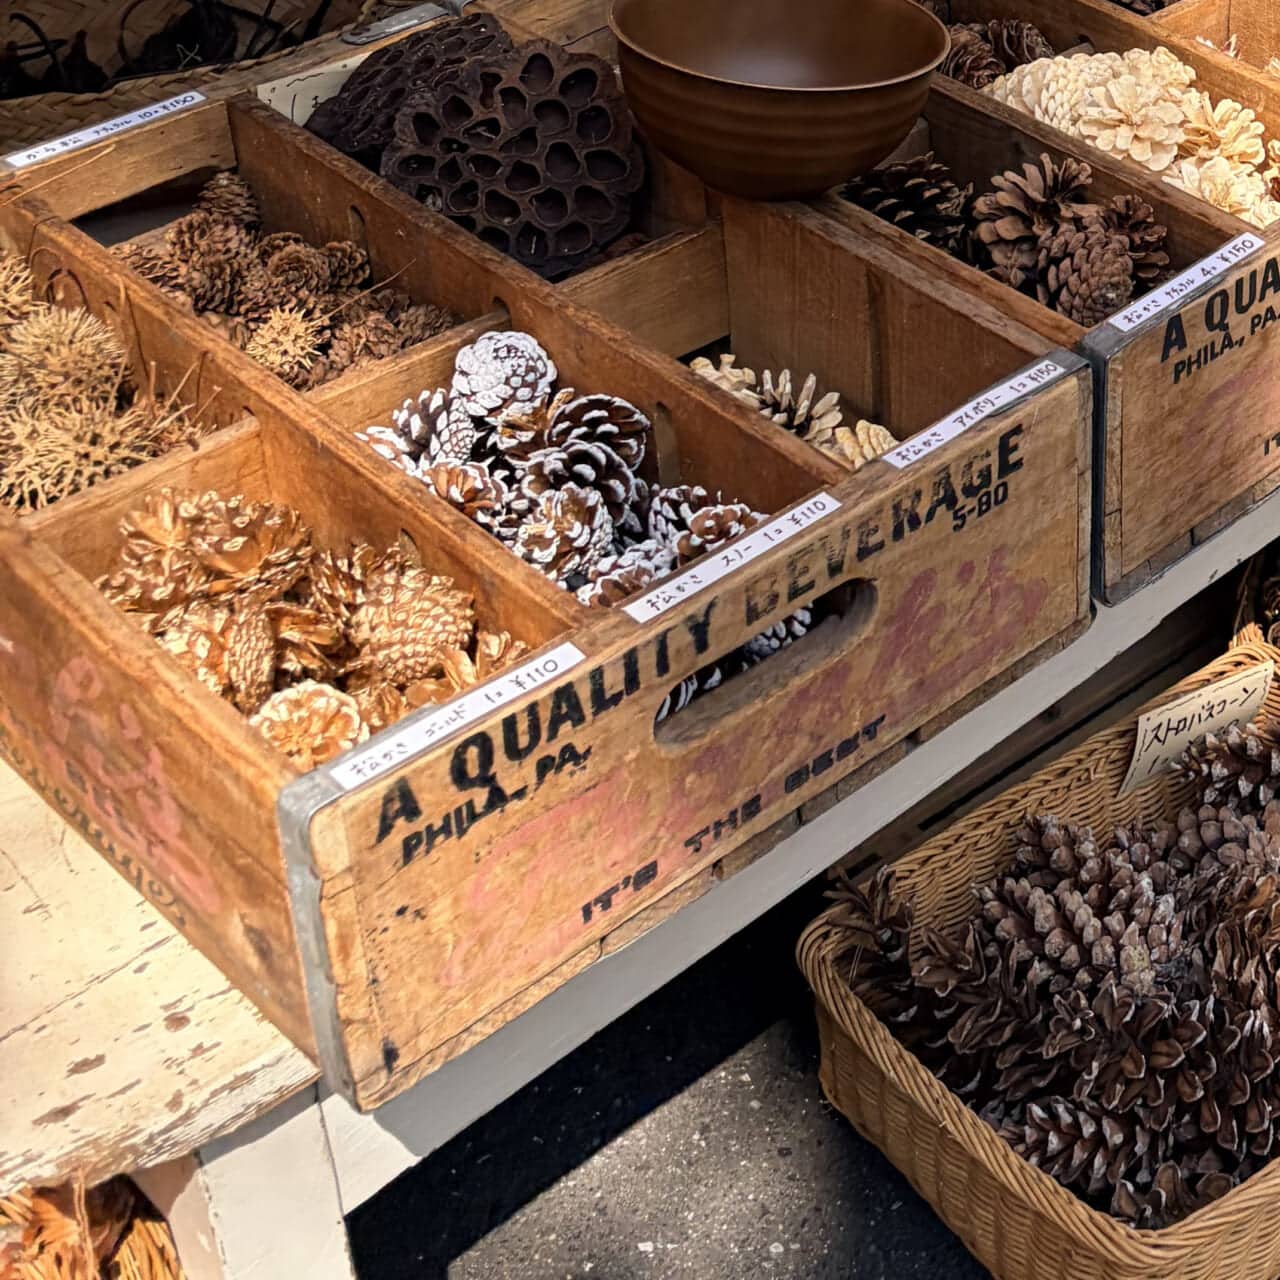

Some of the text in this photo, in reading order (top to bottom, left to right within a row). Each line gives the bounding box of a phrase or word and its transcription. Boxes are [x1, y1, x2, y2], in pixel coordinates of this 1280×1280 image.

[1122, 299, 1162, 325] 松かさ
[1216, 238, 1255, 264] ¥150
[1161, 312, 1187, 363] A
[895, 431, 945, 463] 松かさ
[952, 394, 1002, 428] アイボリー
[1025, 363, 1058, 385] ¥150
[646, 574, 704, 612] 松かさ
[720, 544, 753, 568] スノー
[787, 500, 827, 528] ¥110
[951, 480, 1010, 533] 5-80
[375, 776, 422, 843] A
[449, 593, 719, 793] QUALITY
[744, 423, 1025, 627] BEVERAGE
[350, 741, 409, 778] 松かさ
[425, 703, 466, 738] ゴールド
[508, 658, 559, 691] ¥110
[1143, 687, 1258, 753] ストロバスコーン
[683, 793, 762, 854] THE
[783, 714, 887, 794] BEST
